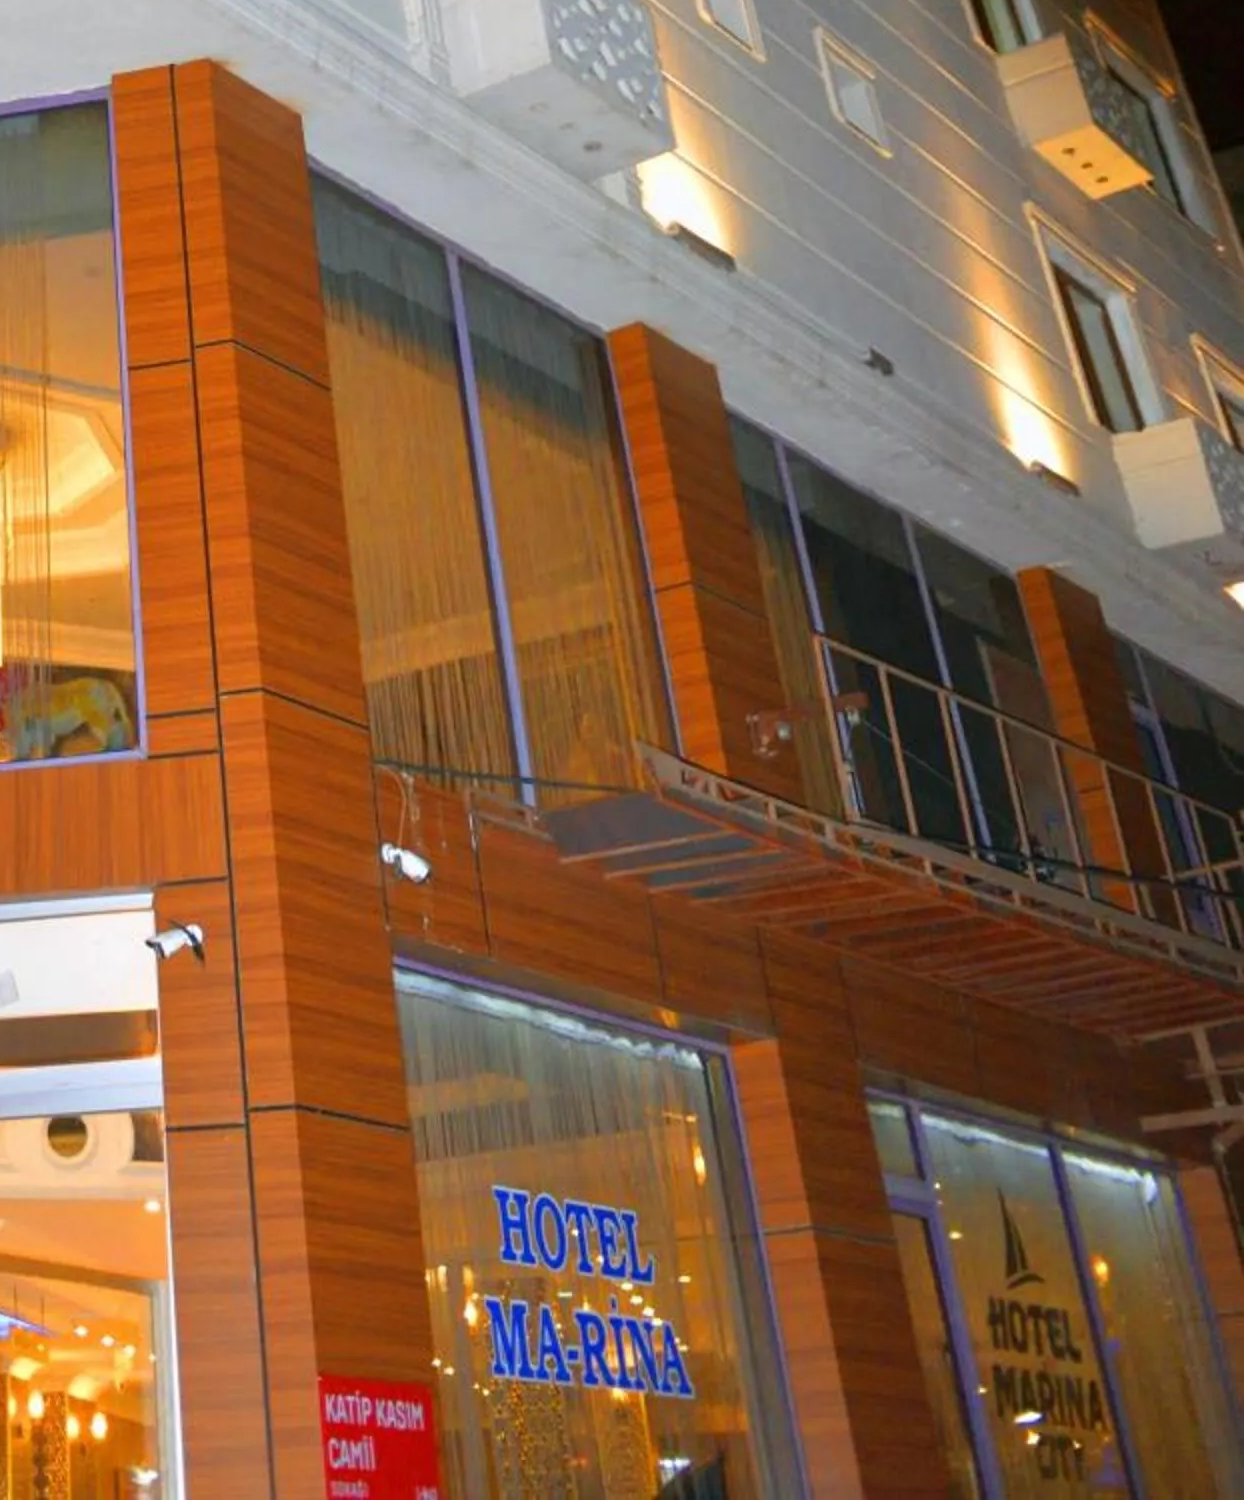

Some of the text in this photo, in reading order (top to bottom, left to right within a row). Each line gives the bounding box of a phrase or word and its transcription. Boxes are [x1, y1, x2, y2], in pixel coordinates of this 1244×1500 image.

[491, 1184, 655, 1285] HOTEL
[483, 1296, 695, 1399] MA-RİNA
[988, 1296, 1082, 1364] HOTEL
[324, 1389, 425, 1432] KATİP KASIM
[992, 1364, 1110, 1436] MARINA
